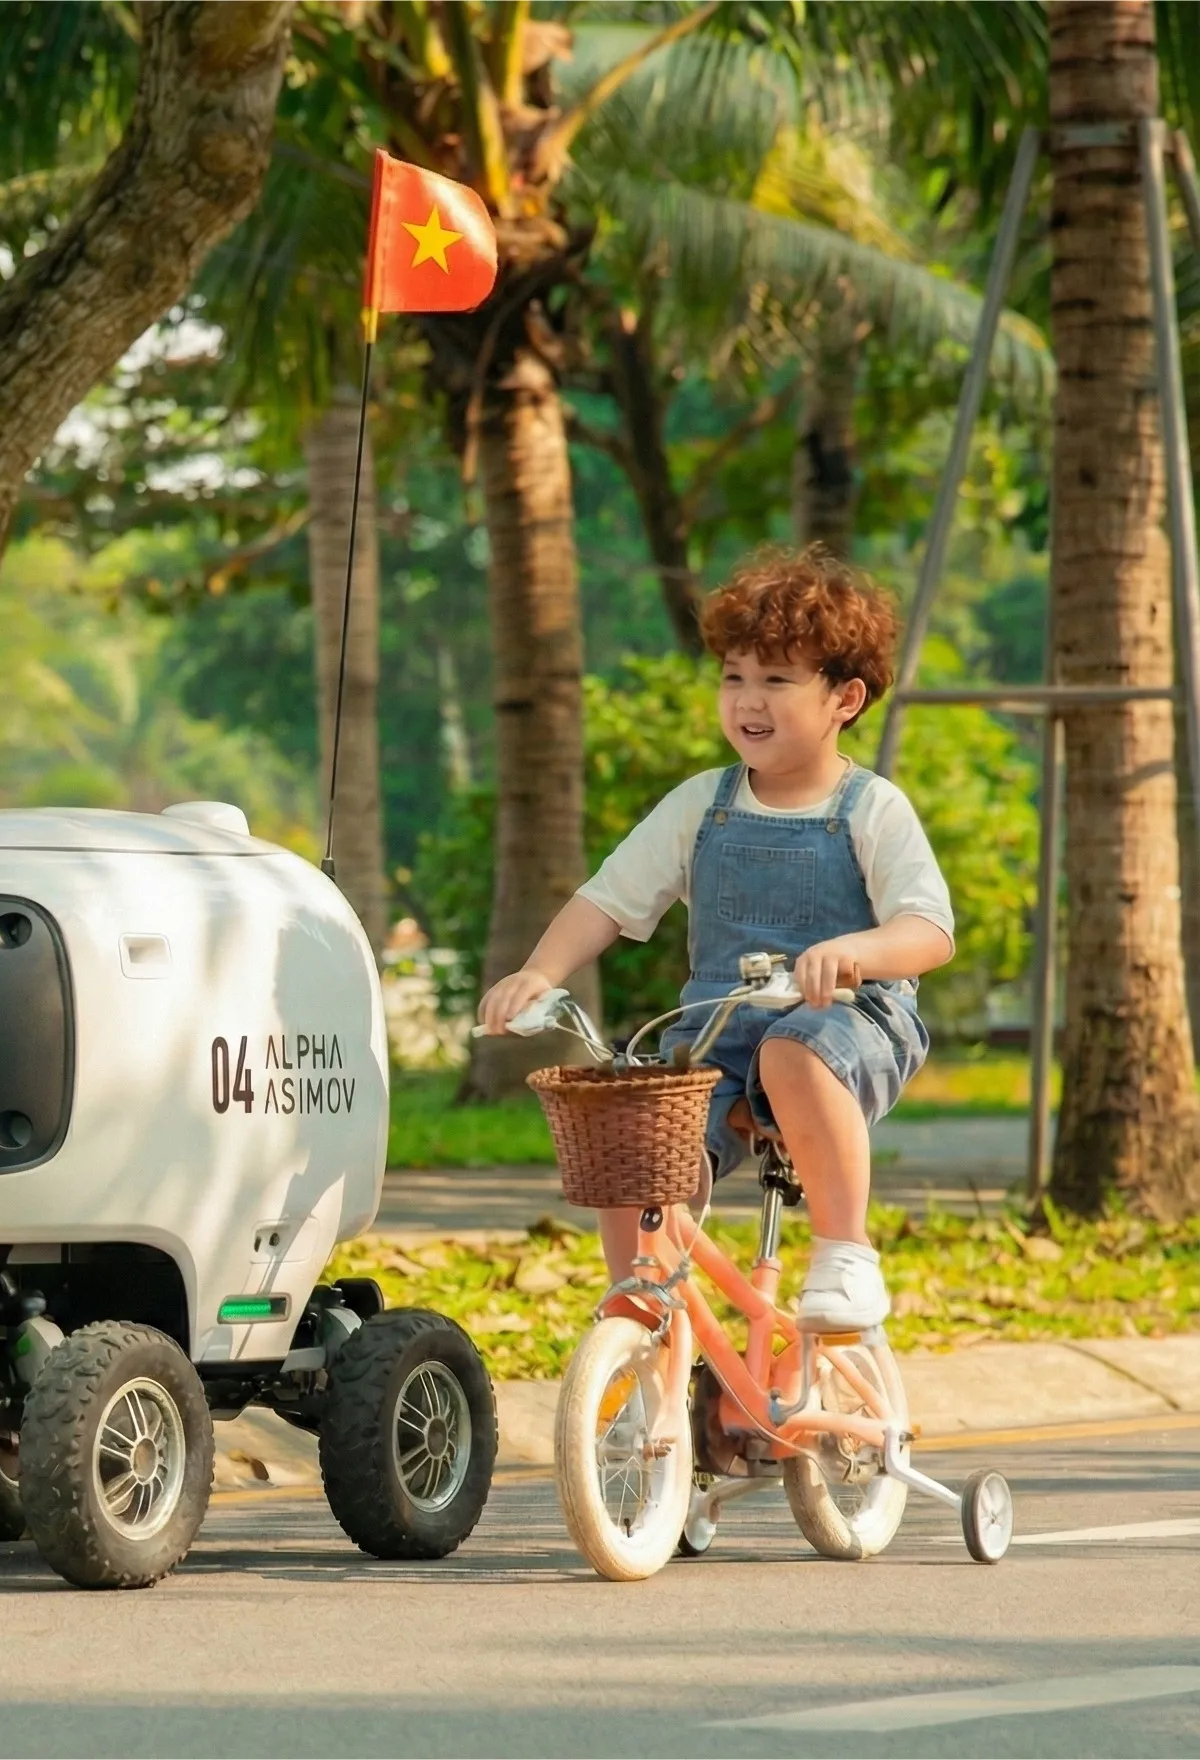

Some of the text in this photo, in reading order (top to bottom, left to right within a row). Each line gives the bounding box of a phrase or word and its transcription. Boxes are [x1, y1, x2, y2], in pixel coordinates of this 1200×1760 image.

[265, 1034, 343, 1069] ALPHA
[211, 1036, 255, 1114] 04
[264, 1077, 355, 1115] ASIMOV
